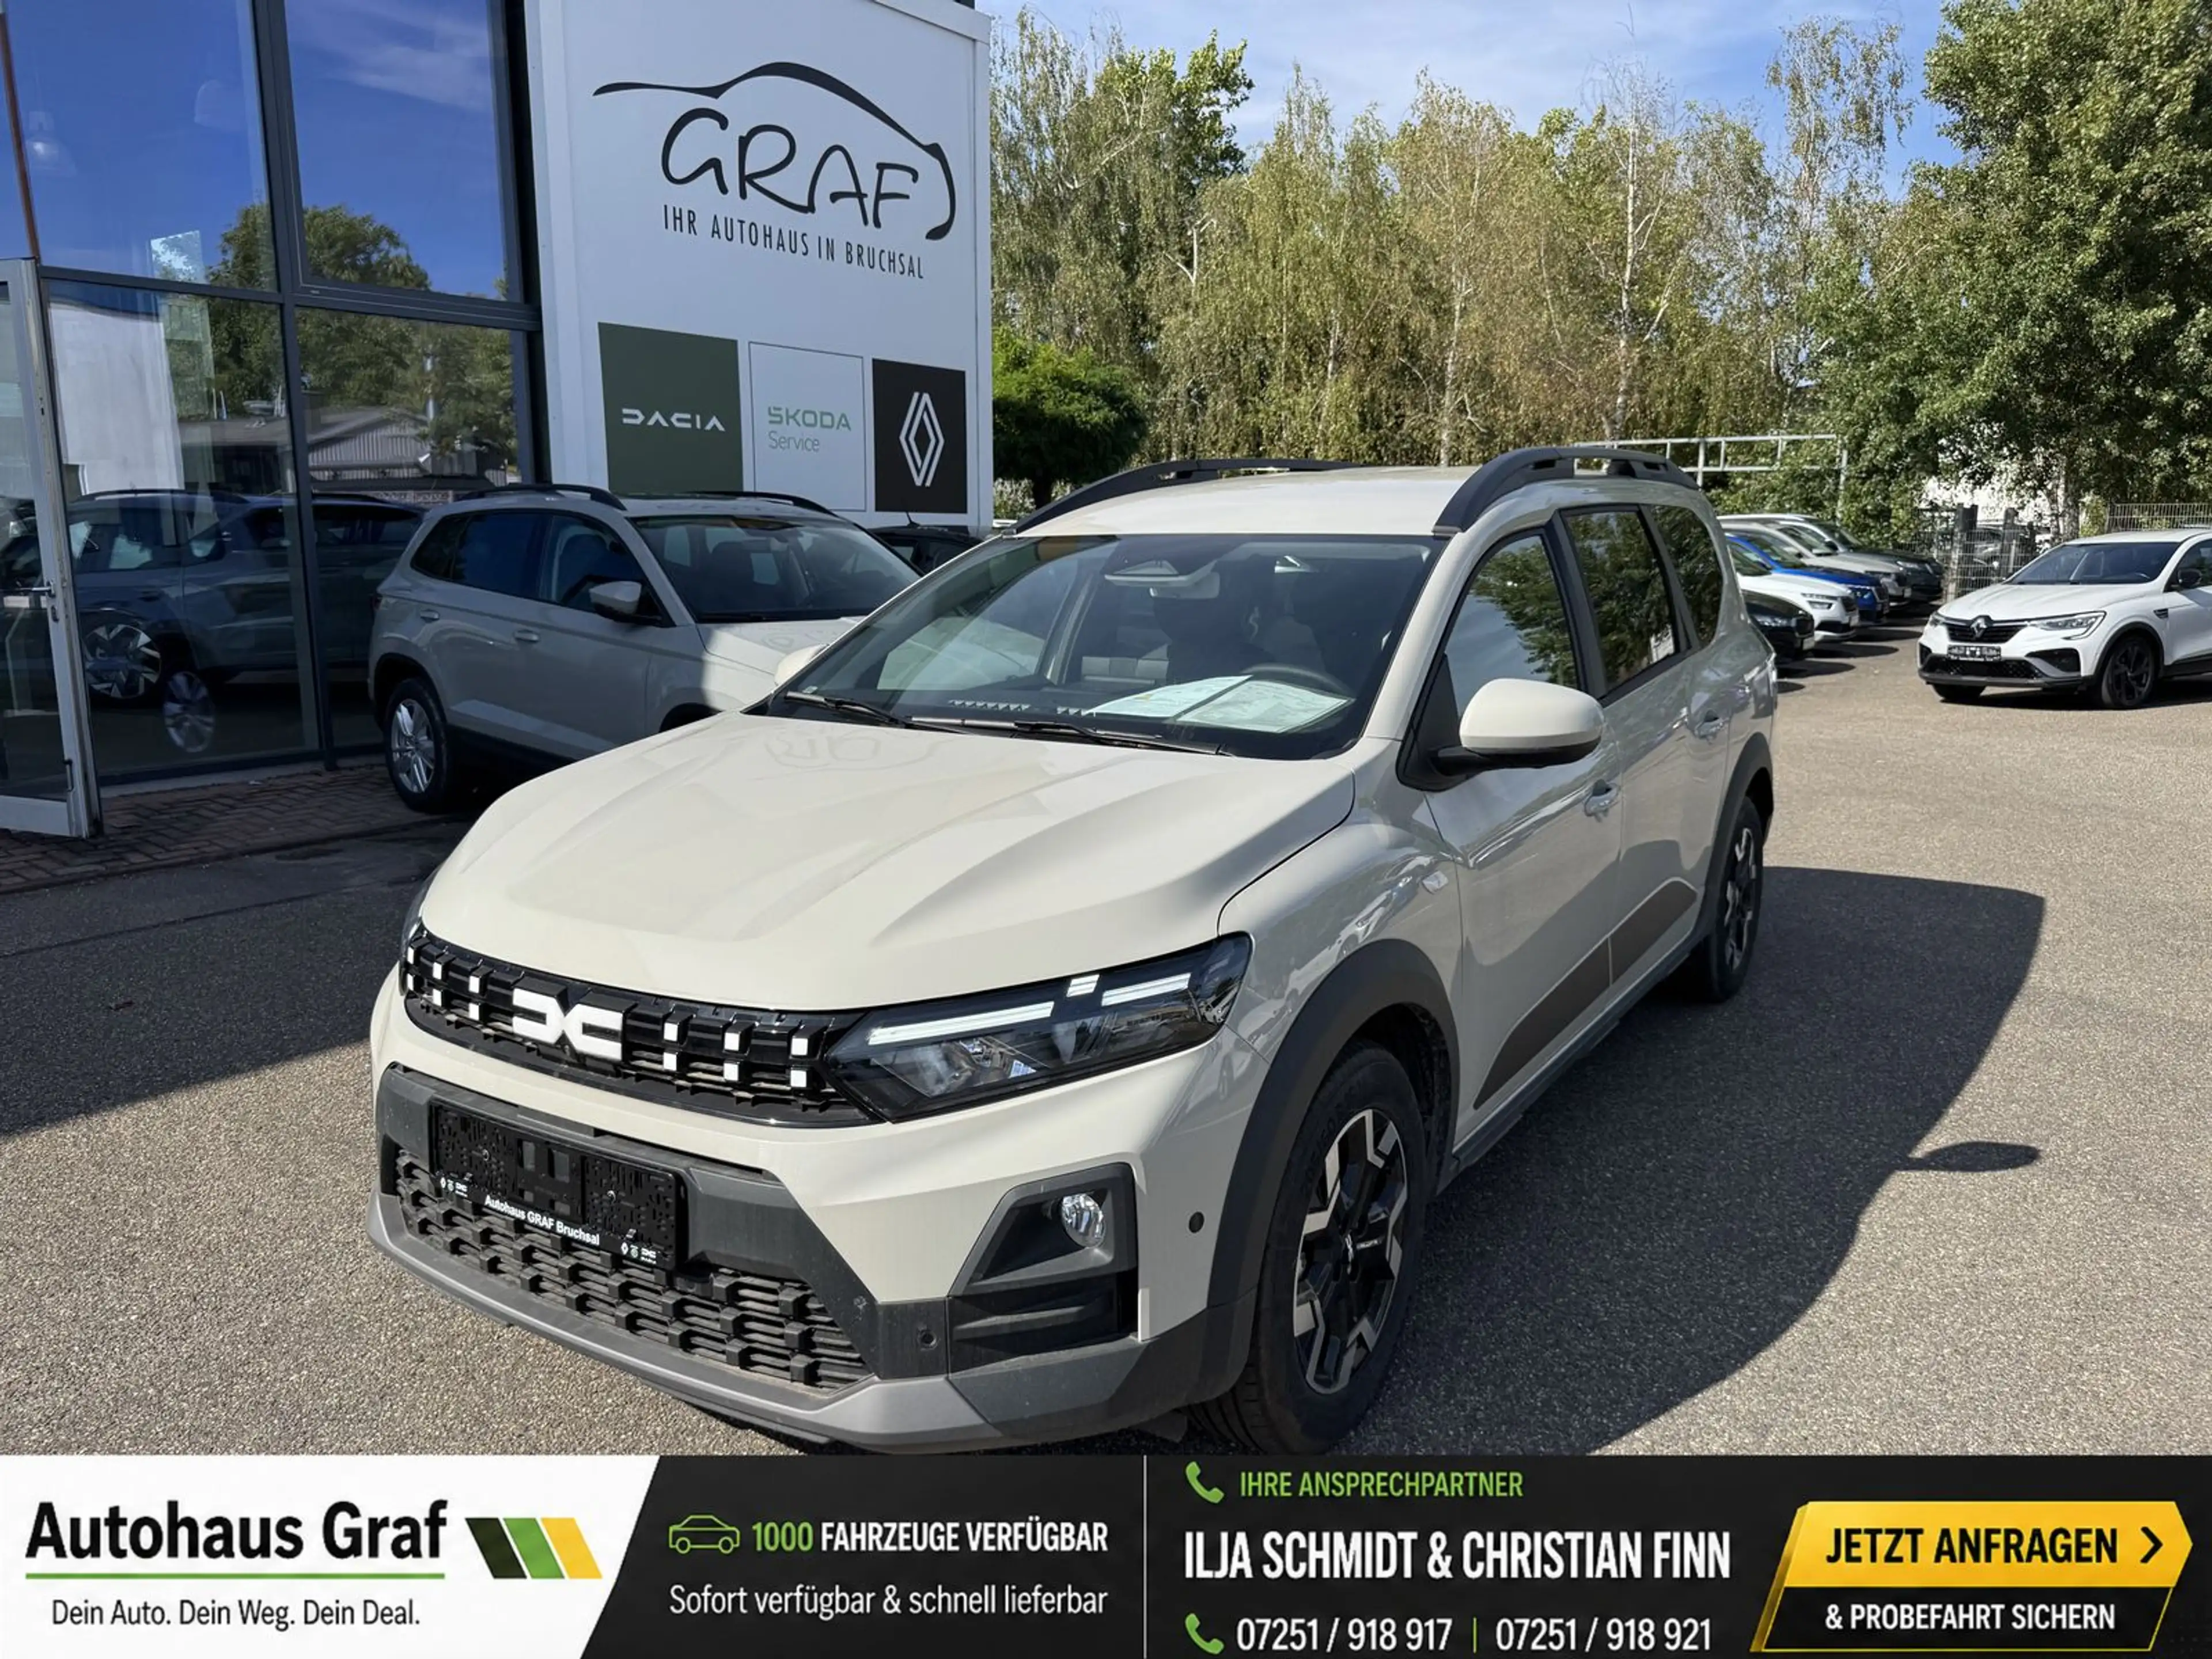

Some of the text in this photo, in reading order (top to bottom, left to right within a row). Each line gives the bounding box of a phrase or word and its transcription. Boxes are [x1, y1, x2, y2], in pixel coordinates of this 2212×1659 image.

[661, 107, 919, 229] GRAF
[663, 204, 924, 279] IHR AUTOHAUS IN BRUCHSAL
[622, 408, 726, 431] DACIA
[768, 430, 820, 452] Service
[484, 1194, 600, 1245] Autohaus GRAF Bruchsal
